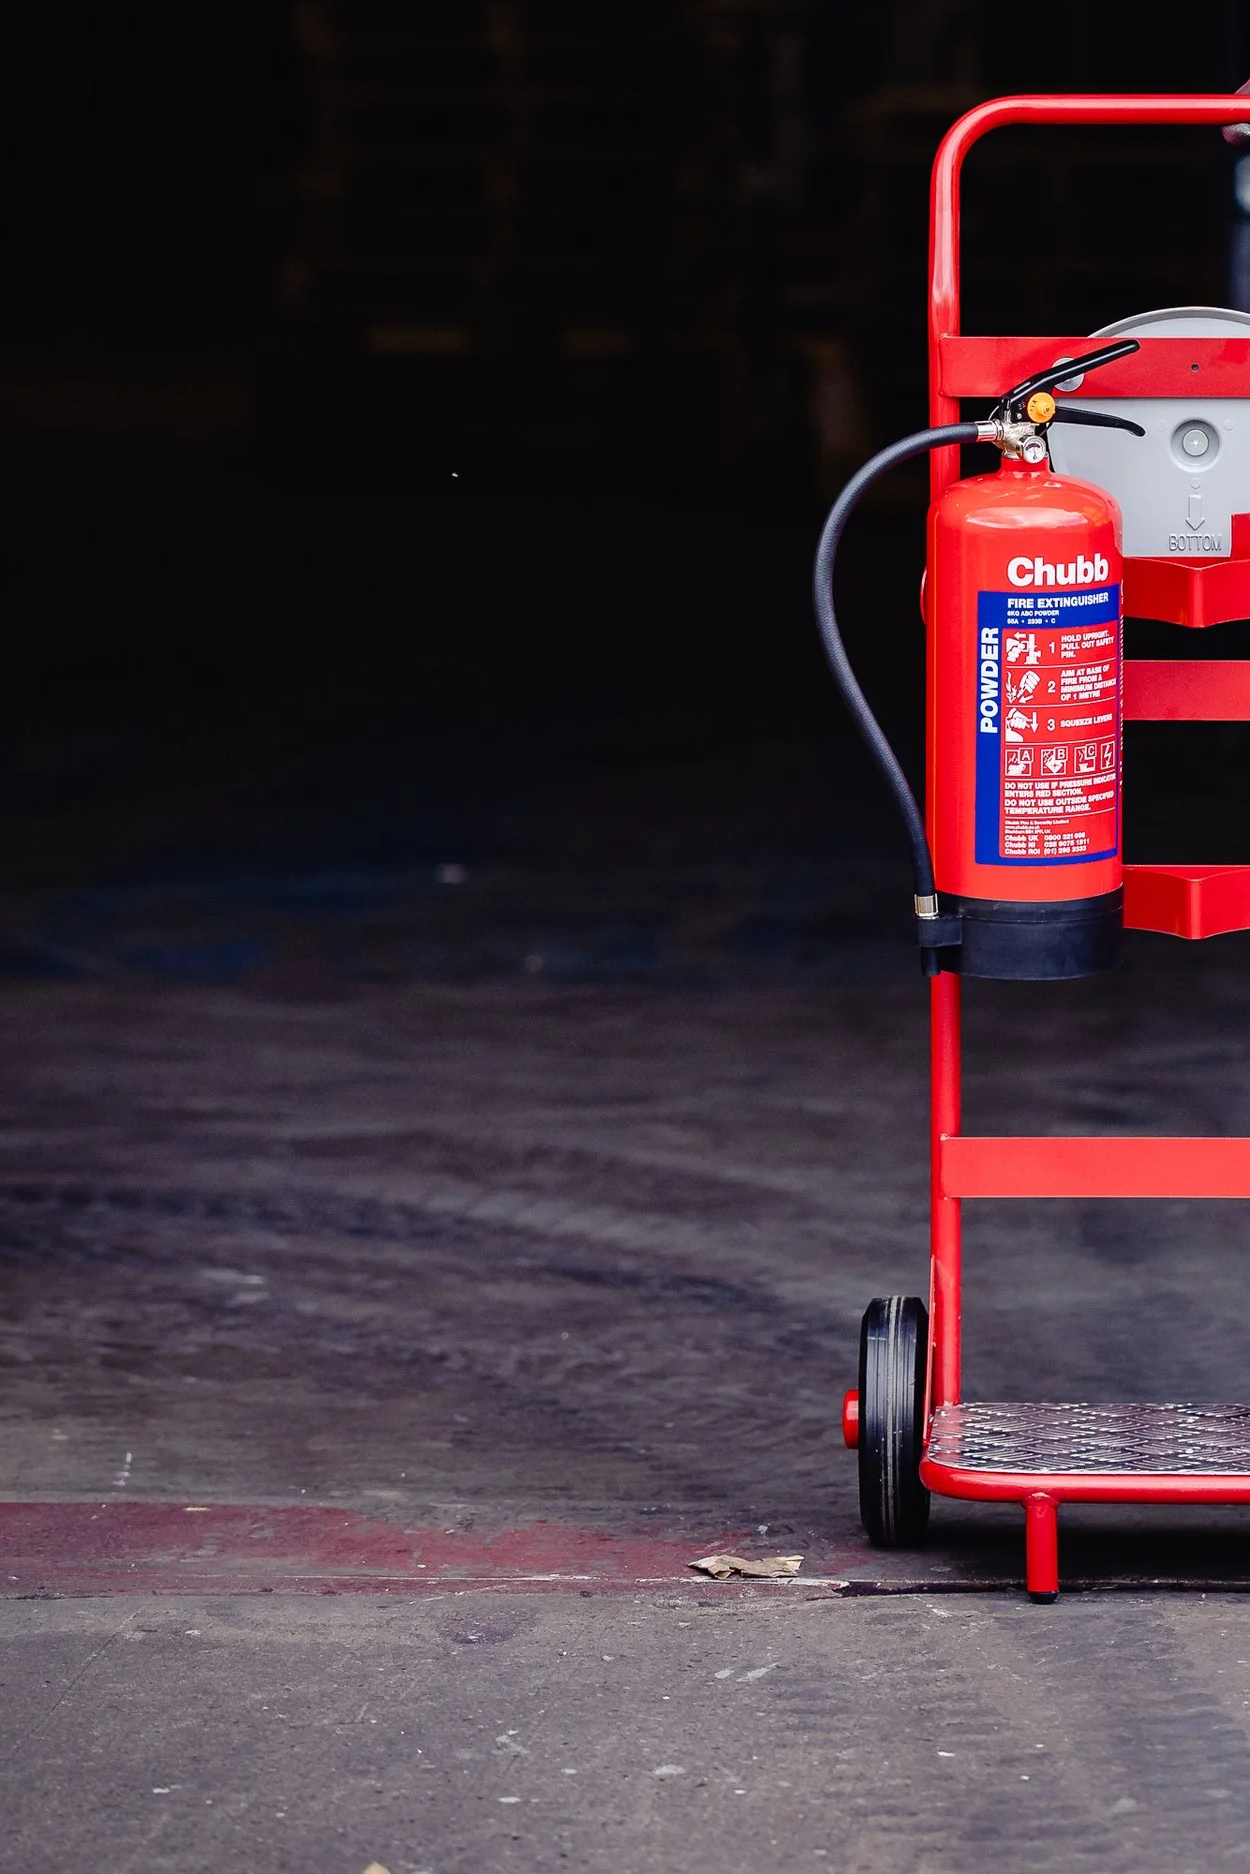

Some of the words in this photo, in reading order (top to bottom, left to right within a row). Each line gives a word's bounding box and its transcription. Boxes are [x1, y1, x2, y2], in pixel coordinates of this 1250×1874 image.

[1169, 533, 1222, 551] BOTTOM
[1007, 553, 1109, 586] Chubb
[1007, 598, 1034, 608] FIRE
[1037, 592, 1109, 608] EXTINGUISHER
[1061, 634, 1081, 642] HOLD
[1083, 630, 1109, 640] UPRIGHT.
[1049, 642, 1055, 654] 1
[1061, 642, 1080, 651] PULL
[1081, 640, 1095, 648] OUT
[1096, 636, 1114, 647] SAFETY
[1061, 669, 1075, 677] AIM
[1076, 668, 1085, 676] AT
[1086, 666, 1102, 675] BASE
[1102, 664, 1110, 672] OF
[980, 627, 999, 733] POWDER
[1047, 681, 1056, 693] 2
[1061, 677, 1077, 685] FIRE
[1079, 675, 1097, 683] FROM
[1061, 683, 1093, 693] MINIMUM
[1094, 678, 1116, 690] DISTANCE
[1079, 690, 1101, 699] METRE
[1047, 719, 1056, 731] 3
[1061, 717, 1093, 727] SQUEEZE
[1093, 713, 1112, 724] LEVERS
[1022, 750, 1031, 761] A
[1057, 749, 1065, 759] B
[1088, 745, 1094, 756] C
[1035, 781, 1049, 789] USE
[1060, 778, 1093, 788] PRESSURE
[1093, 773, 1116, 784] INDICATOR
[1052, 788, 1083, 797] SECTION.
[1056, 796, 1087, 805] OUTSIDE
[1088, 790, 1114, 802] SPECIFIED
[1005, 806, 1064, 815] TEMPERATURE
[1065, 804, 1091, 813] RANGE.
